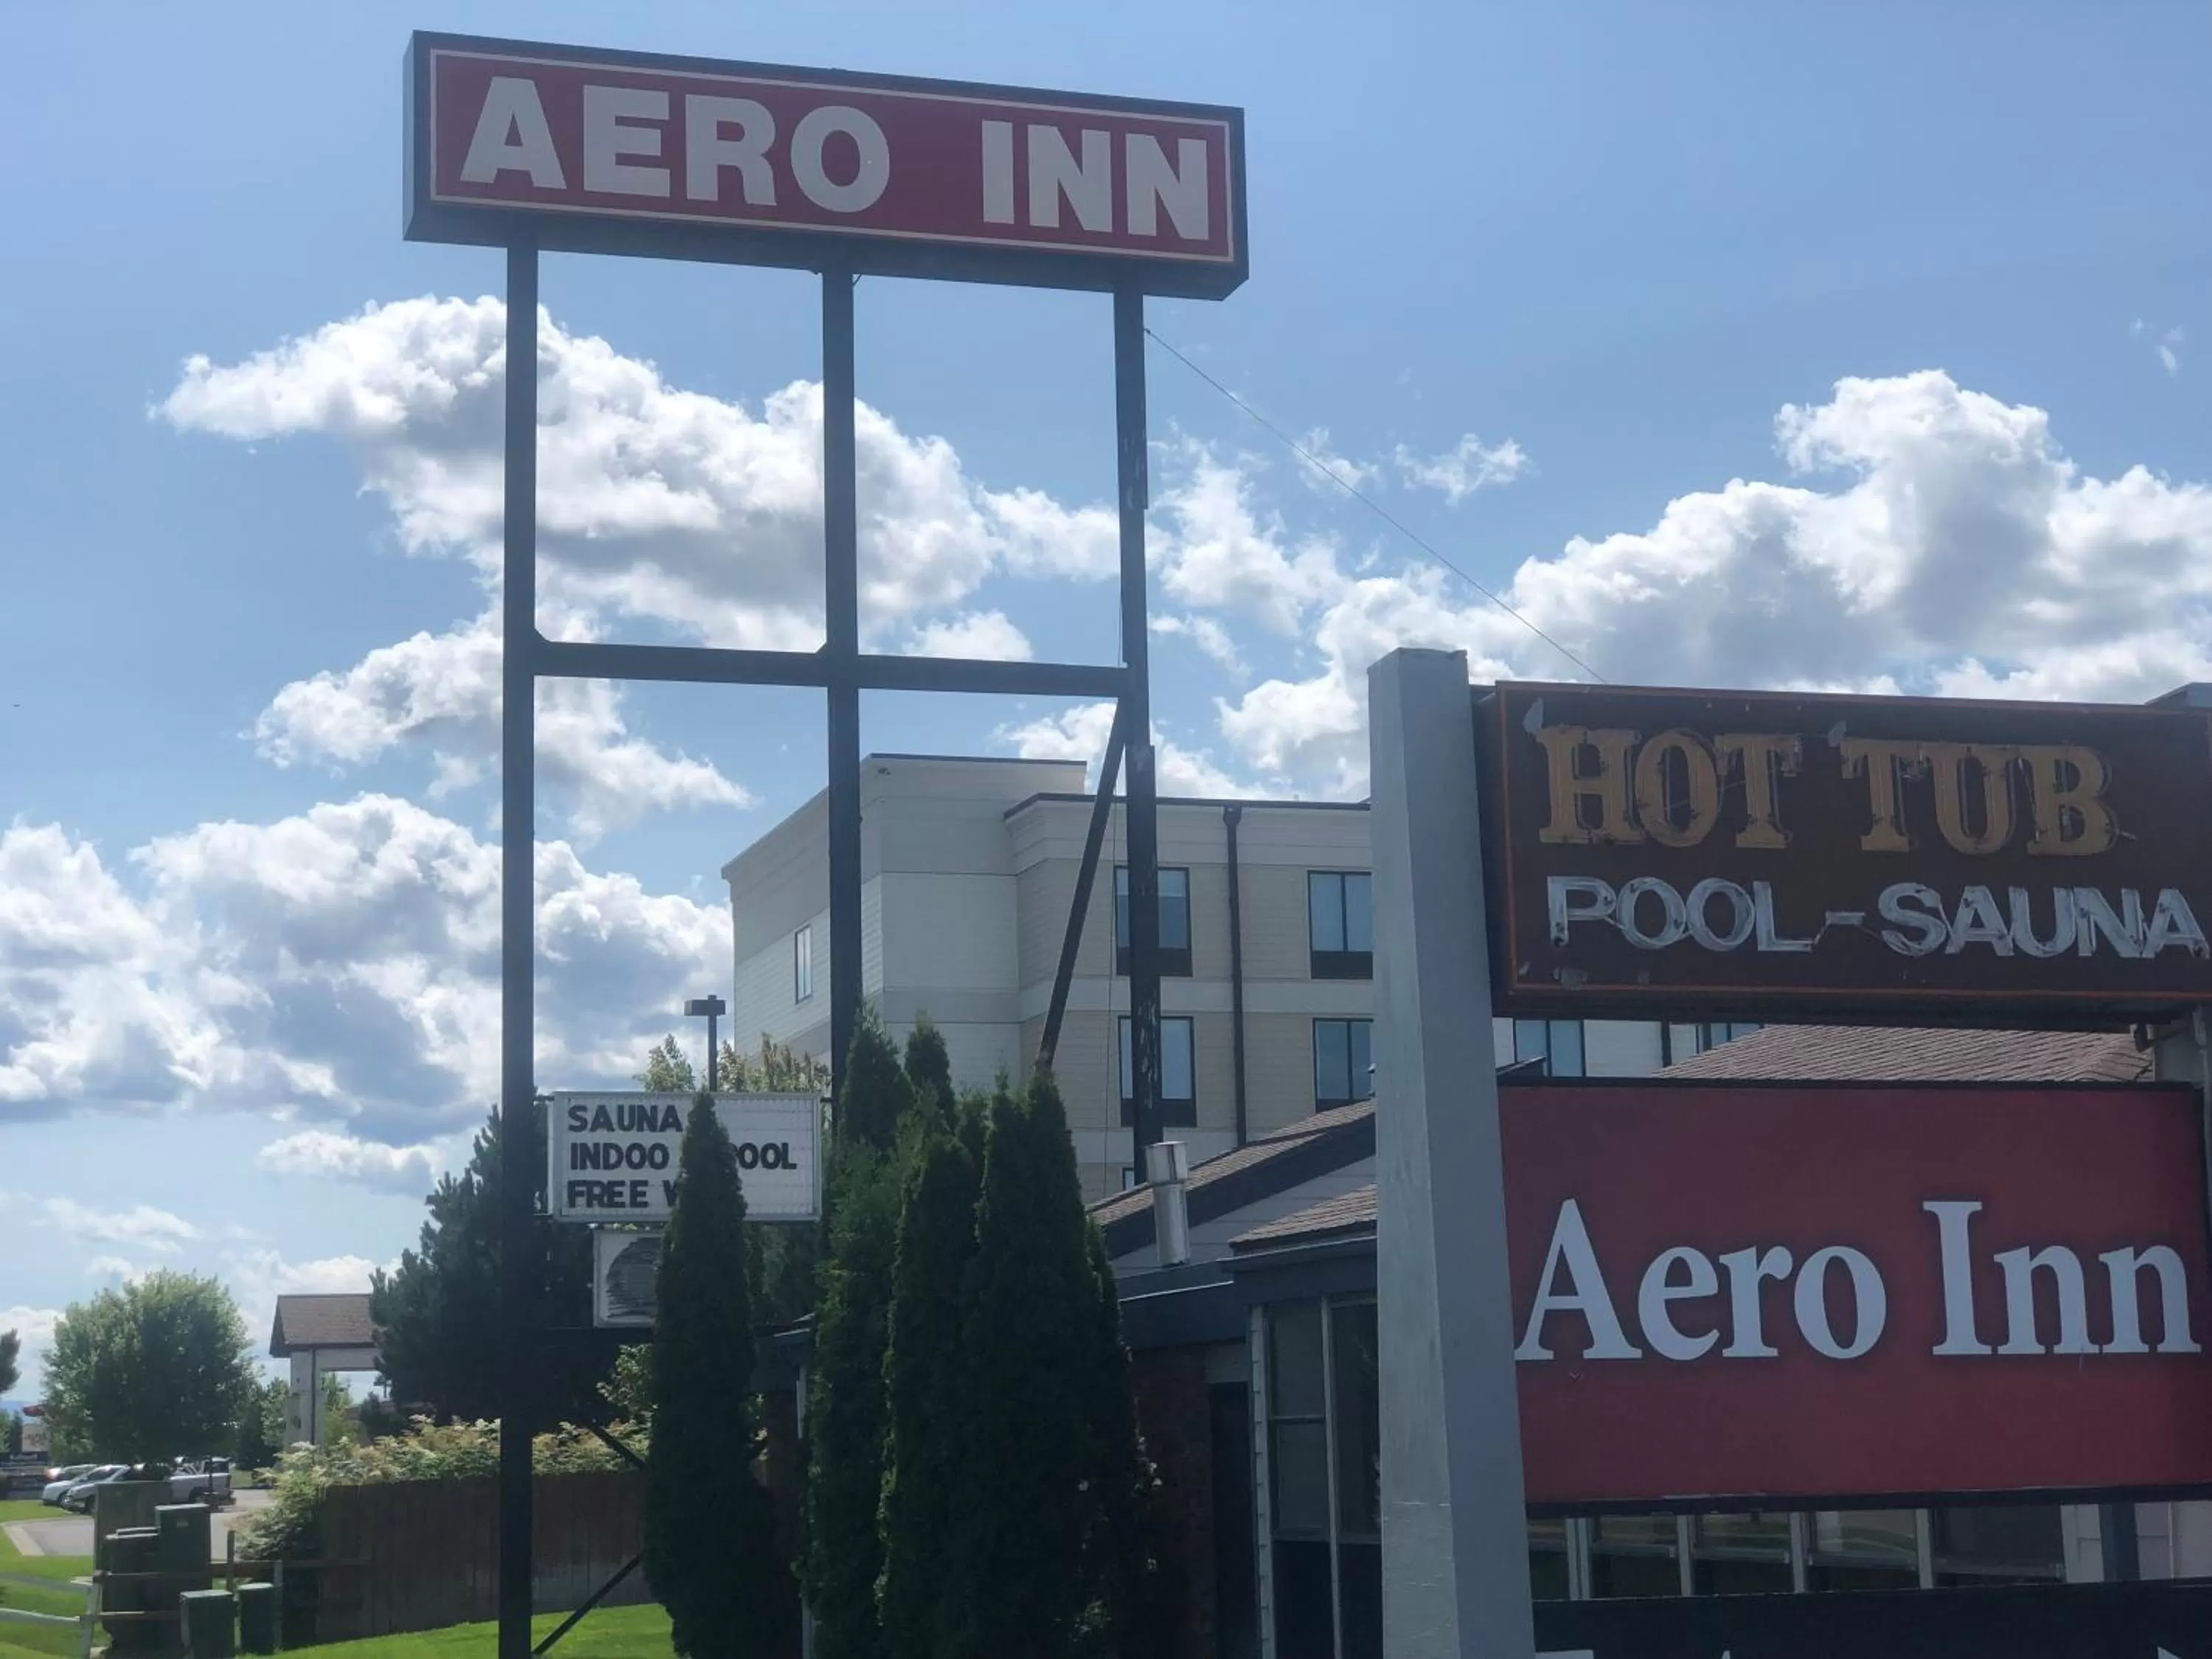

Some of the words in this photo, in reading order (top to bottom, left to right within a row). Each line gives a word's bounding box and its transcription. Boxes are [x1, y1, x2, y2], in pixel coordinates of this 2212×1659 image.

[459, 76, 891, 212] AERO
[981, 119, 1209, 240] INN
[1537, 726, 1804, 849] HOT
[1840, 737, 2118, 857] TUB
[568, 1105, 683, 1133] SAUNA
[570, 1142, 670, 1170] INDOO
[567, 1180, 649, 1208] FREE
[1514, 1198, 1887, 1360] Aero
[1923, 1200, 2202, 1355] Inn
